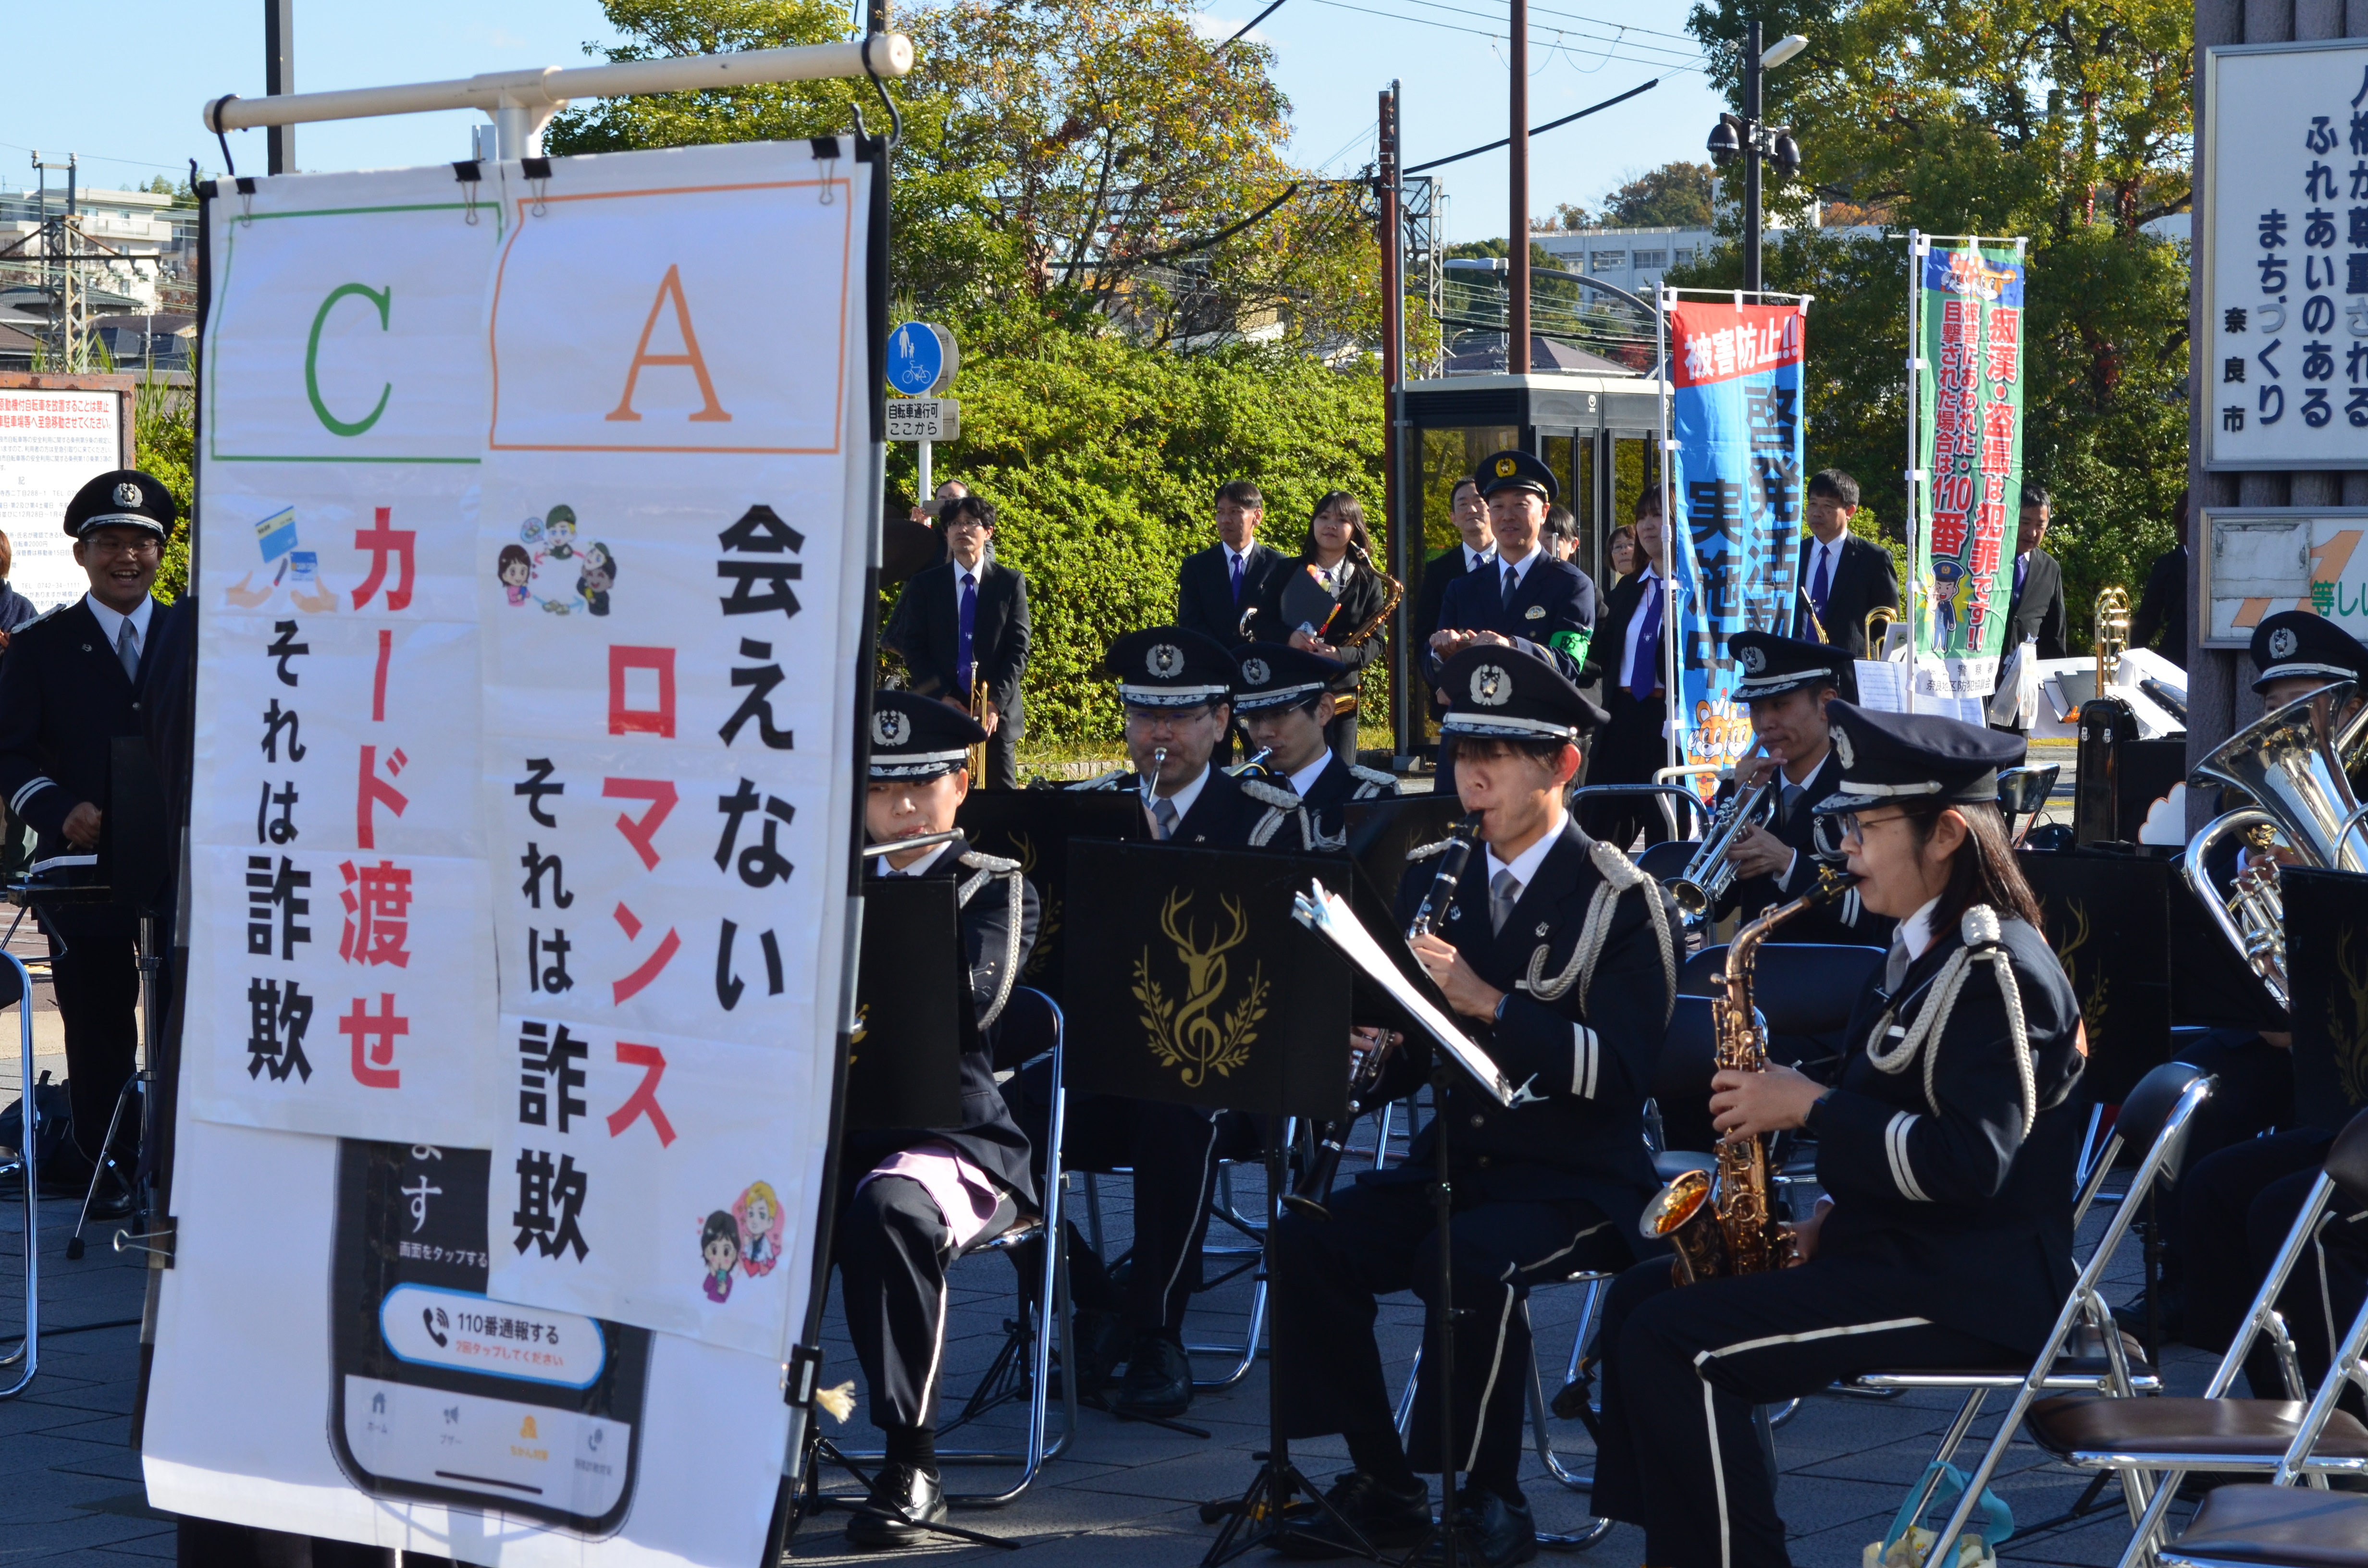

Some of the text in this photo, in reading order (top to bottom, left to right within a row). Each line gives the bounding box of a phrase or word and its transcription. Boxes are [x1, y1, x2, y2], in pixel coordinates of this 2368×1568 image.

[305, 282, 392, 437] C
[604, 263, 732, 422] A
[1684, 313, 1799, 380] 被害防止!!
[2257, 208, 2288, 426] まちづくり
[2301, 116, 2339, 428] ふれあいのある
[889, 403, 938, 419] 自転車通行可
[890, 422, 937, 435] ここから
[2223, 307, 2247, 433] 奈良市
[1685, 478, 1743, 689] 実施中
[337, 506, 417, 1090] カード渡せ
[714, 504, 806, 1012] 会えない
[246, 619, 314, 1085] それは詐欺
[602, 644, 682, 1150] ロマンス
[513, 758, 590, 1264] それは詐欺
[399, 1240, 489, 1268] 画面をタップする
[457, 1312, 559, 1345] 110番通報する
